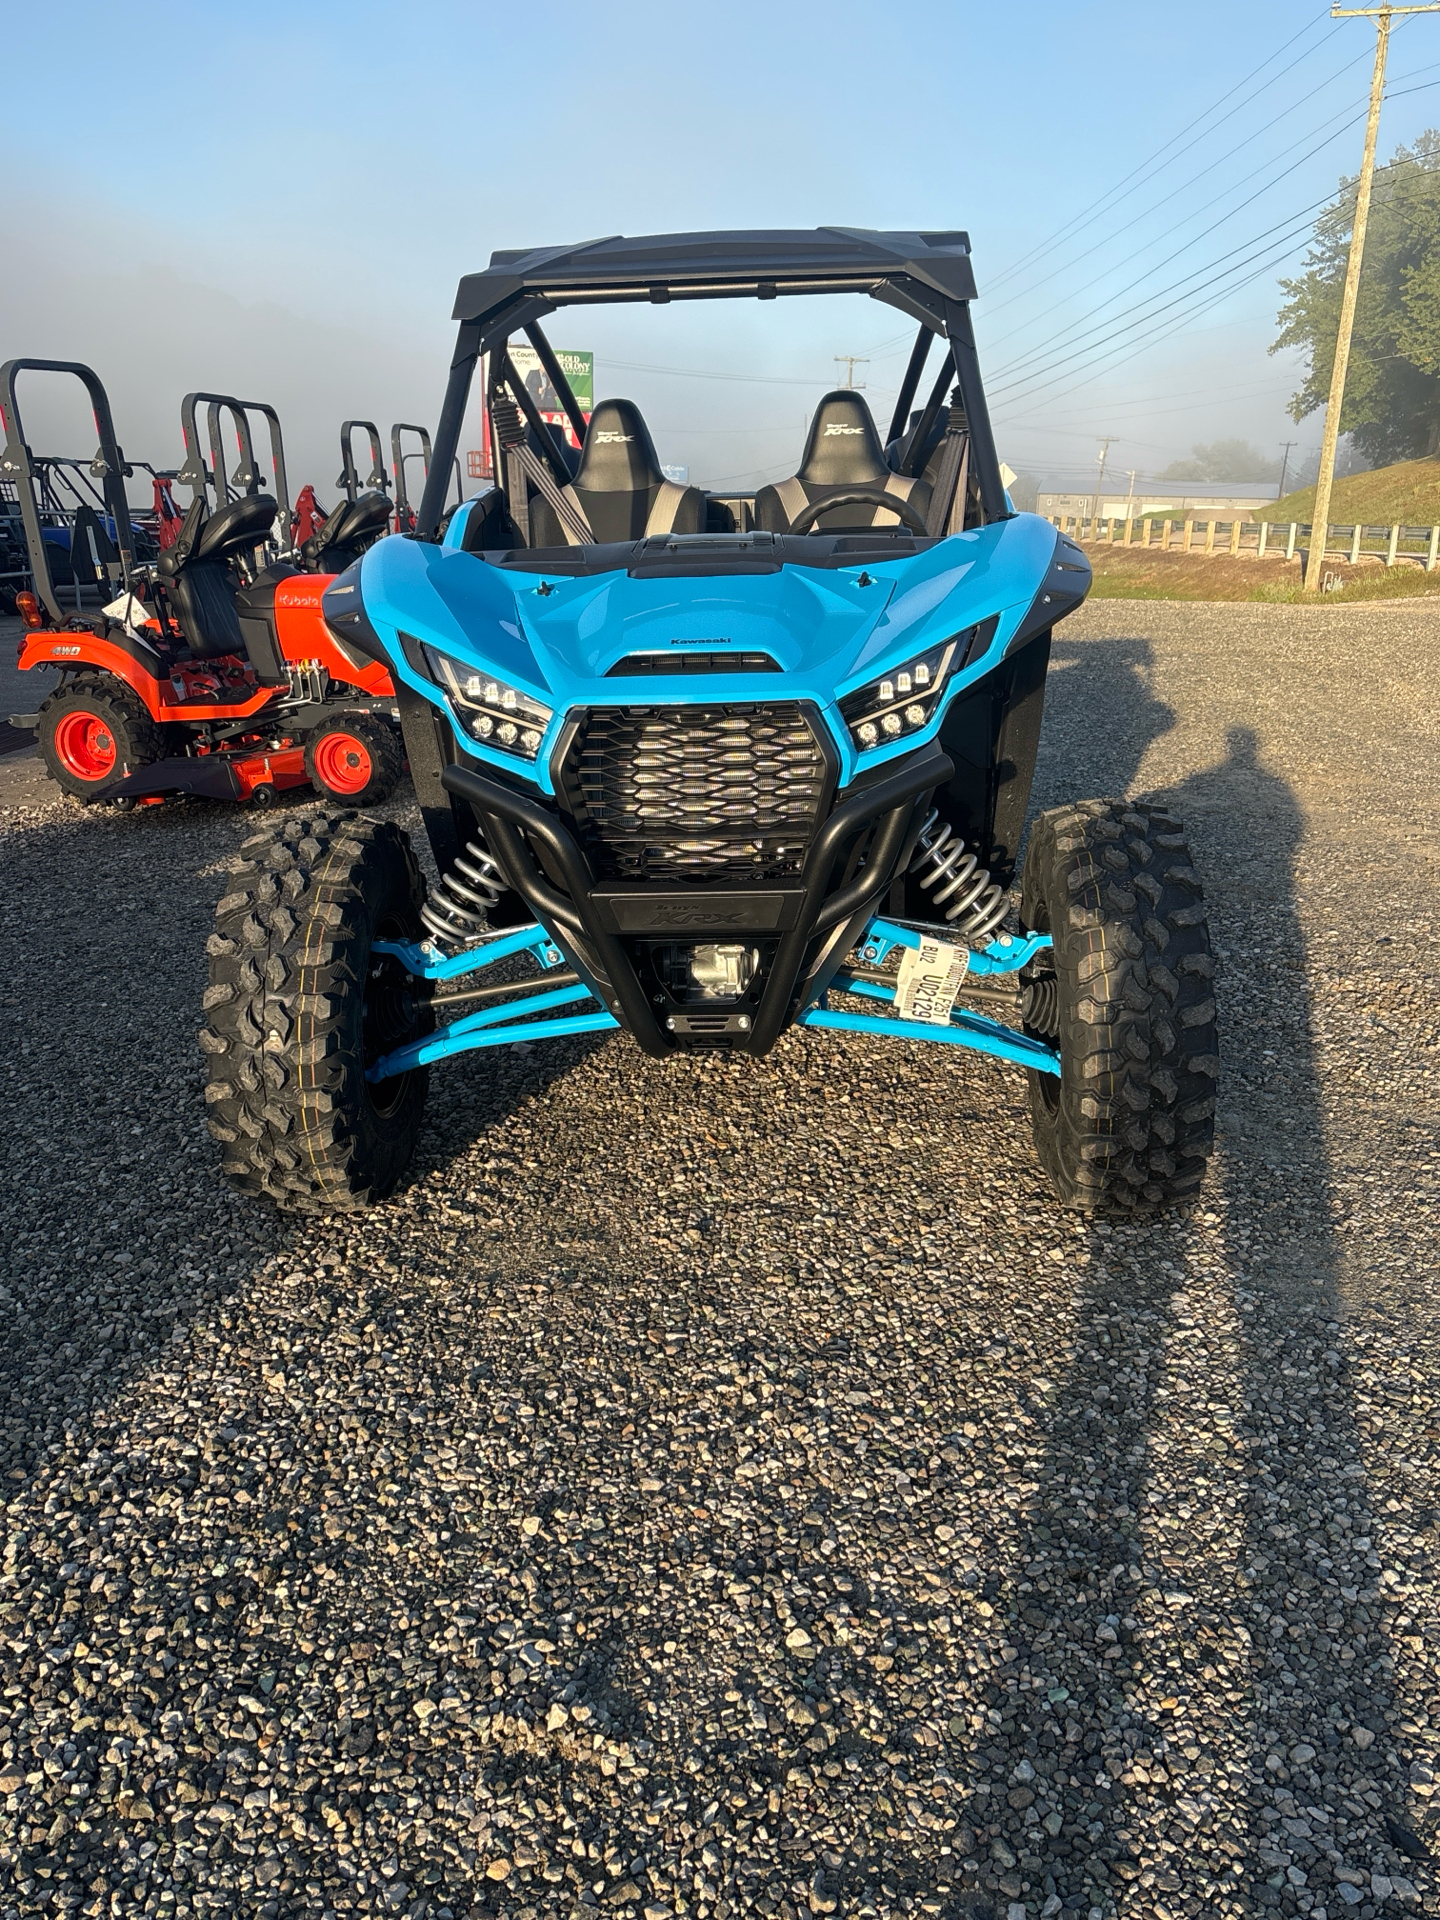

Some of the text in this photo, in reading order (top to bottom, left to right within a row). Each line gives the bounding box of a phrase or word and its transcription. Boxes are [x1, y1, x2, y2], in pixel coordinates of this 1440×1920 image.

[565, 355, 580, 363] OLD
[560, 362, 590, 373] COLONY
[279, 594, 319, 606] Kubota
[671, 637, 732, 645] Kawasaki
[50, 646, 81, 656] 4WD
[648, 912, 748, 926] KRX
[919, 945, 939, 964] BU2
[911, 974, 944, 1019] U02129
